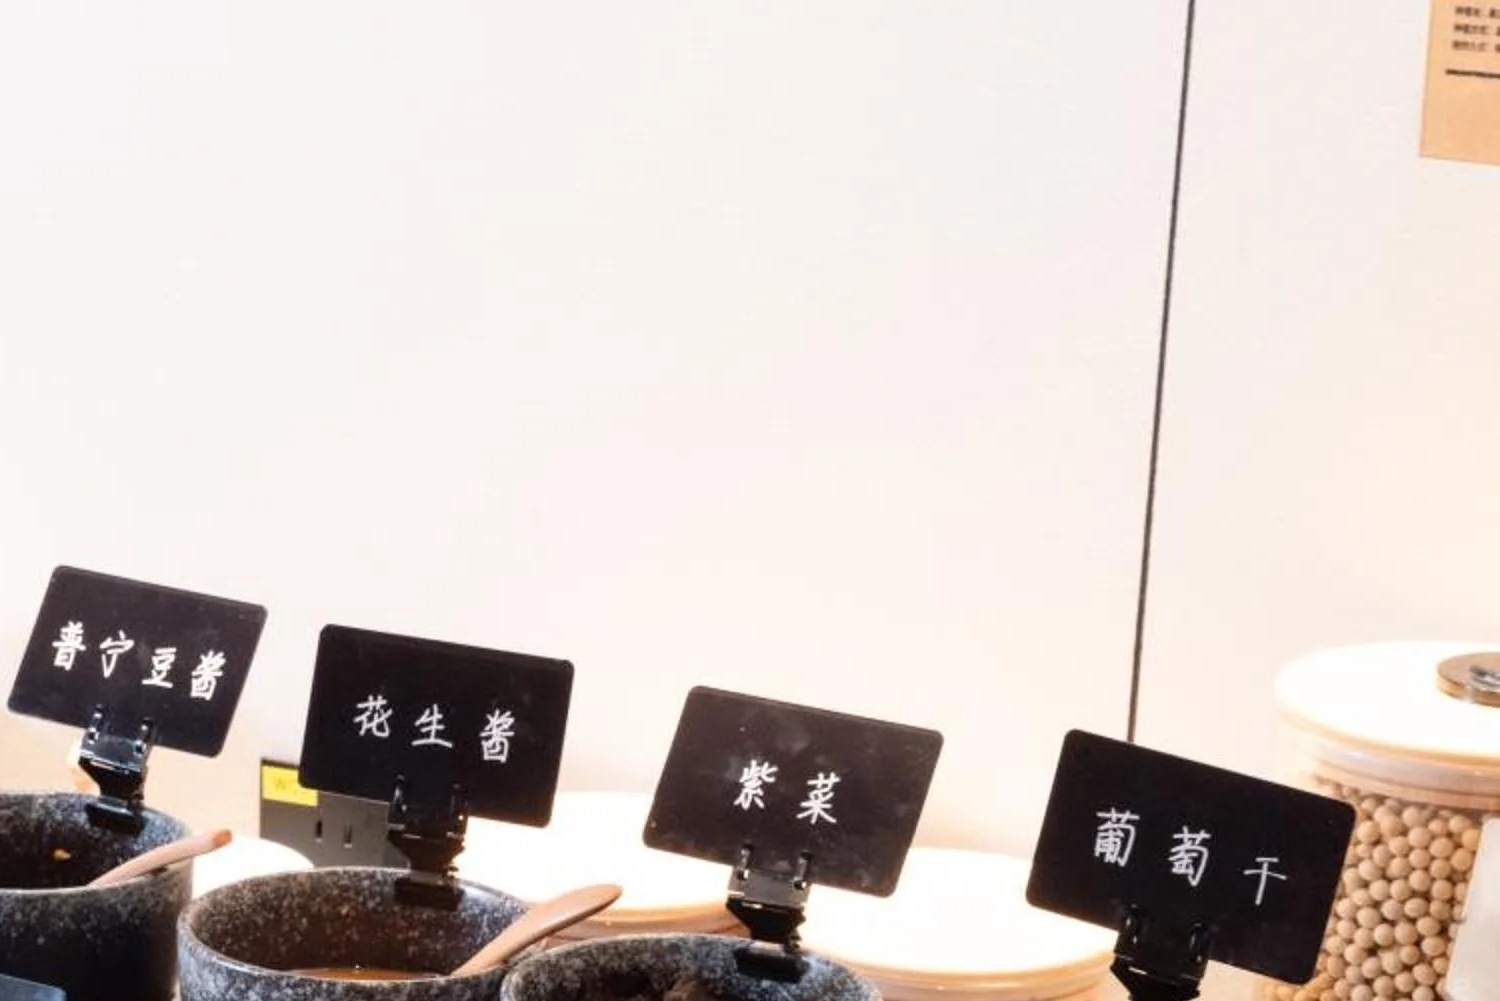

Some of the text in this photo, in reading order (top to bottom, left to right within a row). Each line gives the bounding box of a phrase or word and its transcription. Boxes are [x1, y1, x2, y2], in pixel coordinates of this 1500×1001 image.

[51, 620, 227, 702] 普宁豆酱
[352, 694, 516, 764] 花生酱
[733, 758, 842, 825] 紫菜
[1093, 806, 1288, 906] 葡萄干
